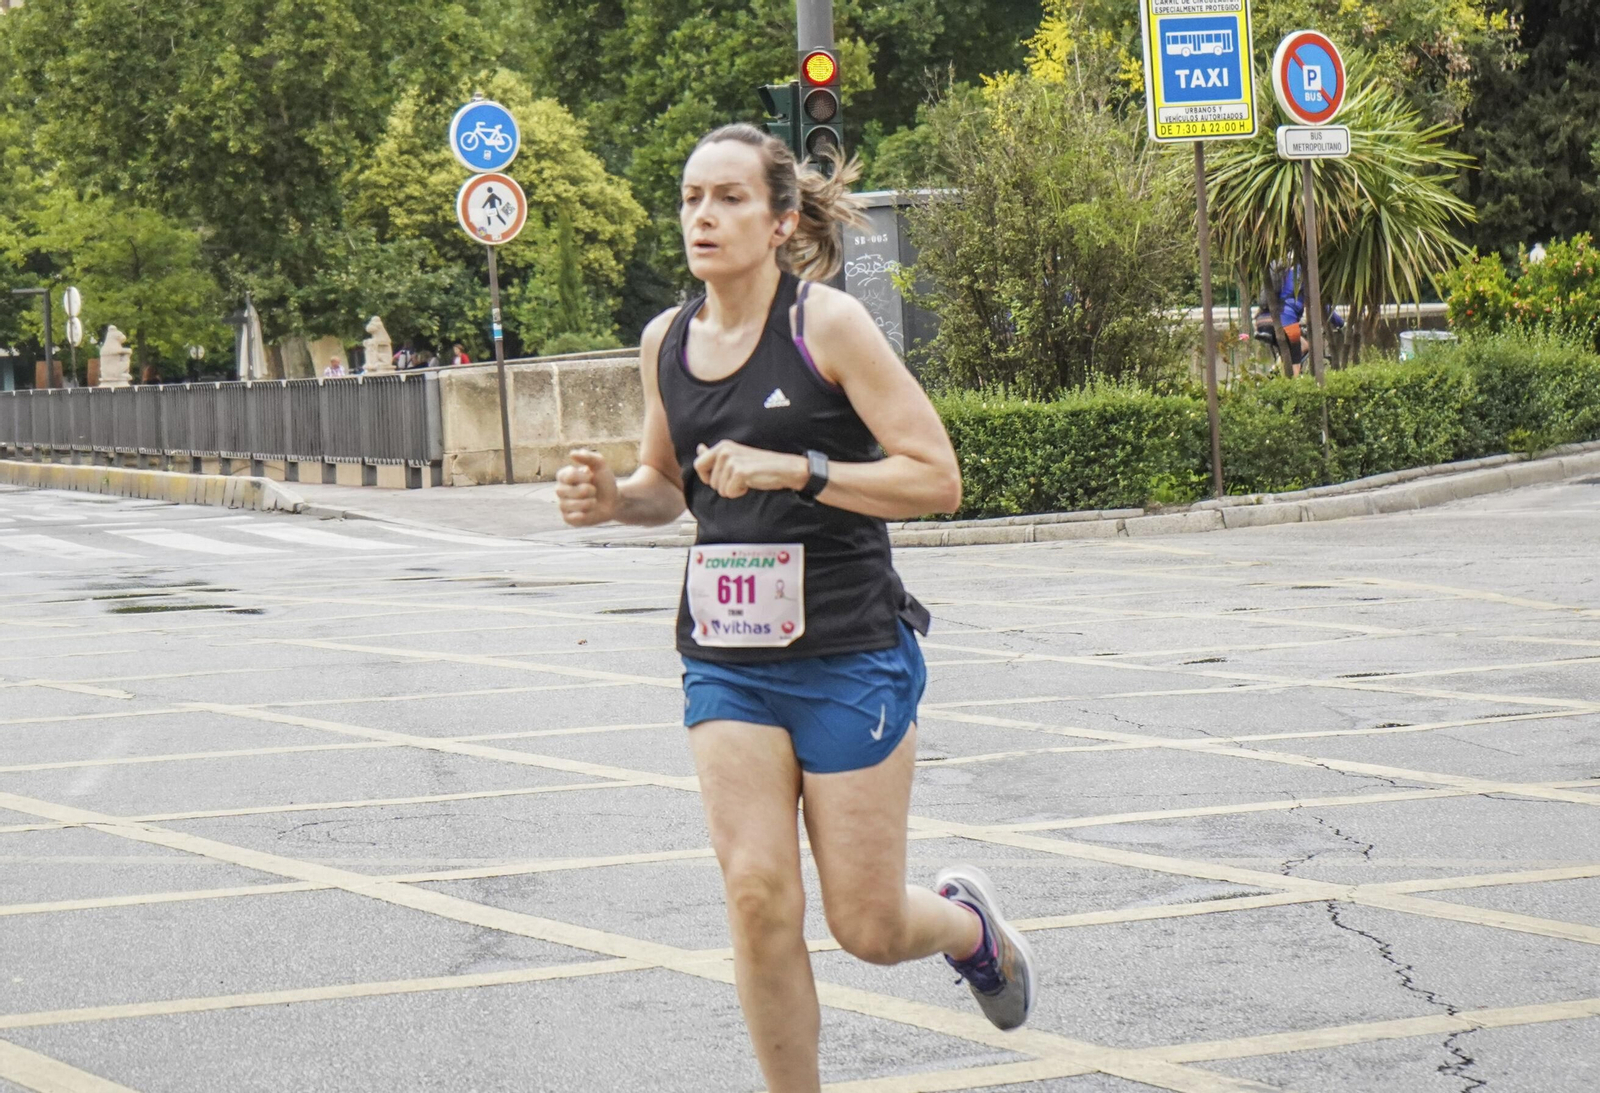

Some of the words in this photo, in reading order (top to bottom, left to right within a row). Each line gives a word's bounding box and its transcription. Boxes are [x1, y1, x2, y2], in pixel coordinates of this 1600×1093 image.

[1175, 68, 1229, 89] TAXI
[1307, 69, 1317, 86] P
[1305, 92, 1322, 101] BUS
[1165, 114, 1198, 122] VEHÍCULOS
[1161, 125, 1172, 135] DE
[1176, 124, 1197, 134] 7:30
[1201, 123, 1206, 133] A
[1210, 122, 1236, 132] 22:00
[1310, 132, 1322, 140] BUS
[1293, 143, 1341, 152] METROPOLITANO
[717, 575, 755, 604] 611
[723, 620, 771, 634] vithas
